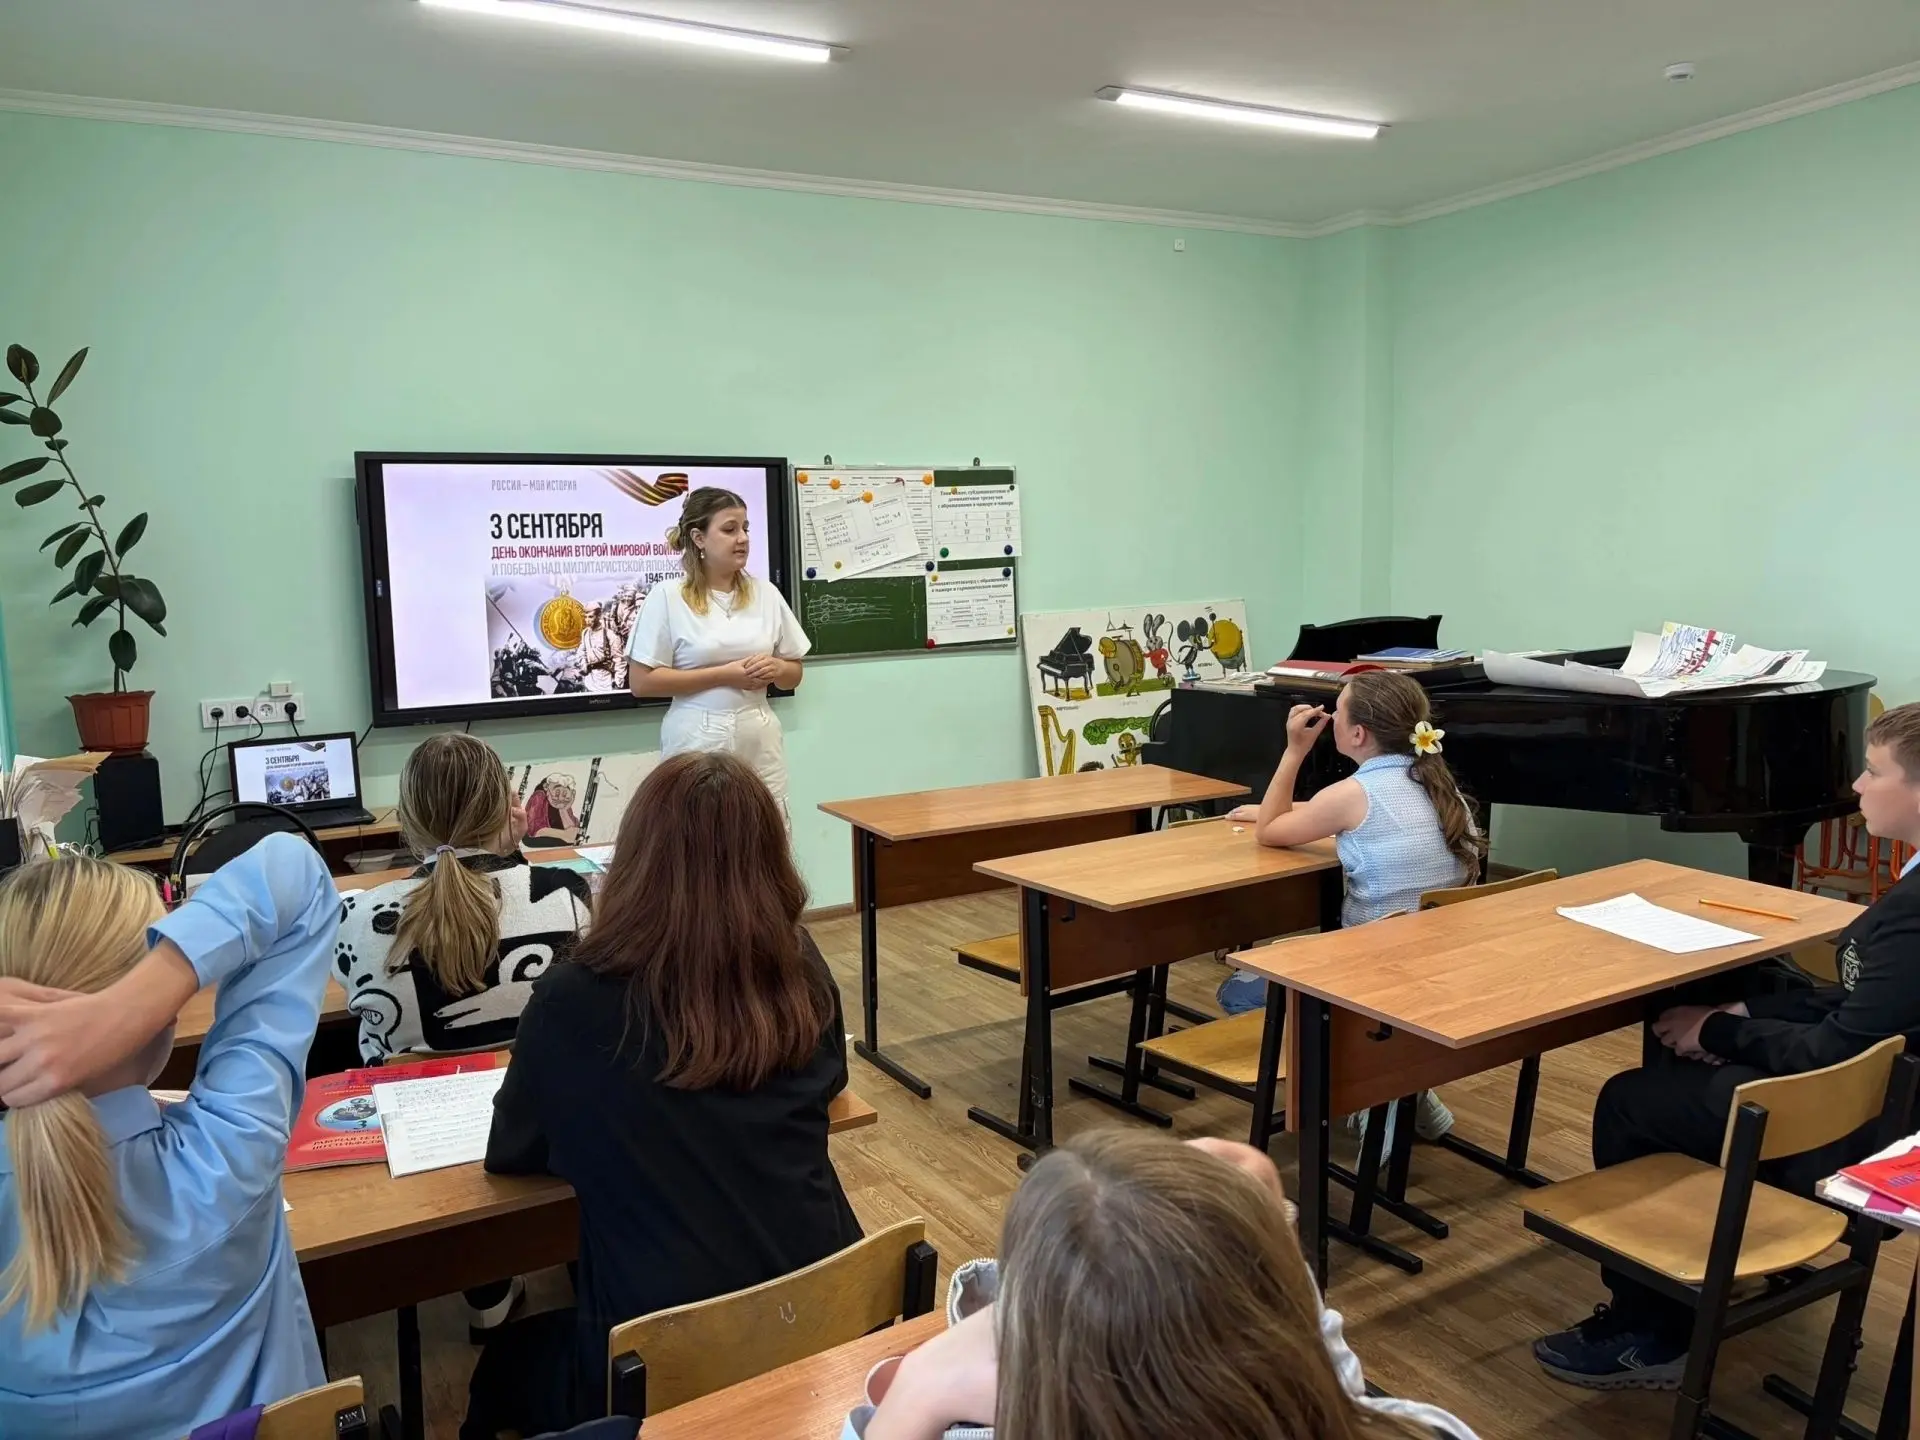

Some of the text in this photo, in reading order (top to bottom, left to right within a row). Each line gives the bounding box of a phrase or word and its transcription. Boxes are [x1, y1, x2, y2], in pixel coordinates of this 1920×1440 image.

[491, 479, 522, 491] РОССИЯ
[529, 479, 545, 491] МОЯ
[546, 479, 577, 491] ИСТОРИЯ
[490, 513, 603, 539] 3 СЕНТЯБРЯ
[491, 546, 517, 560] ДЕНЬ
[518, 545, 573, 558] ОКОНЧАНИЯ
[574, 542, 608, 557] ВТОРОЙ
[610, 542, 652, 556] МИРОВОЙ
[492, 563, 499, 576] И
[500, 562, 540, 576] ПОБЕДЫ
[541, 561, 562, 575] НАД
[562, 558, 645, 574] МИЛИТАРИСТСКОЙ
[645, 572, 664, 584] 1945
[265, 757, 270, 765] 3
[270, 754, 300, 765] СЕНТЯБРЯ
[353, 1120, 367, 1130] 3
